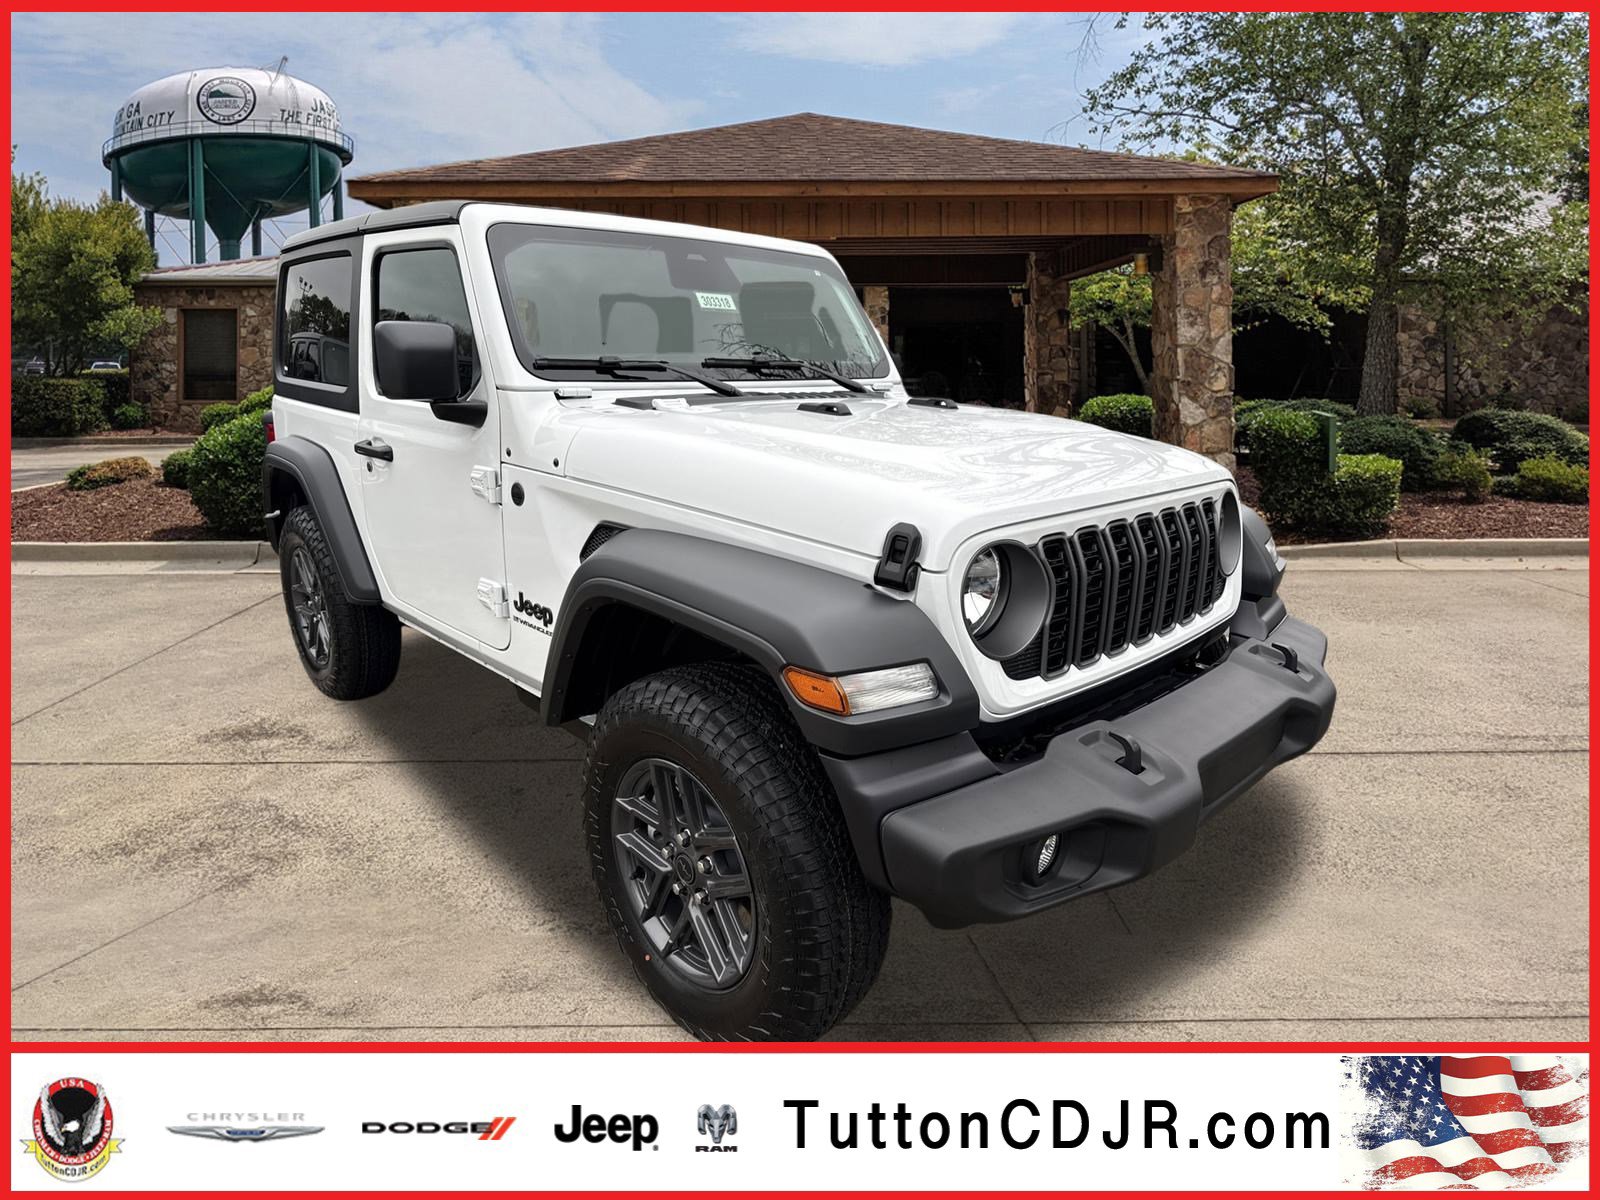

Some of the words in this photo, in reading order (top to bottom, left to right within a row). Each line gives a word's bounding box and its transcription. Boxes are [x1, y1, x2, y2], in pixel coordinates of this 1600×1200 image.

[126, 100, 141, 119] GA
[279, 109, 302, 124] THE
[147, 110, 175, 127] CITY
[700, 295, 732, 308] 303318
[513, 591, 553, 628] Jeep
